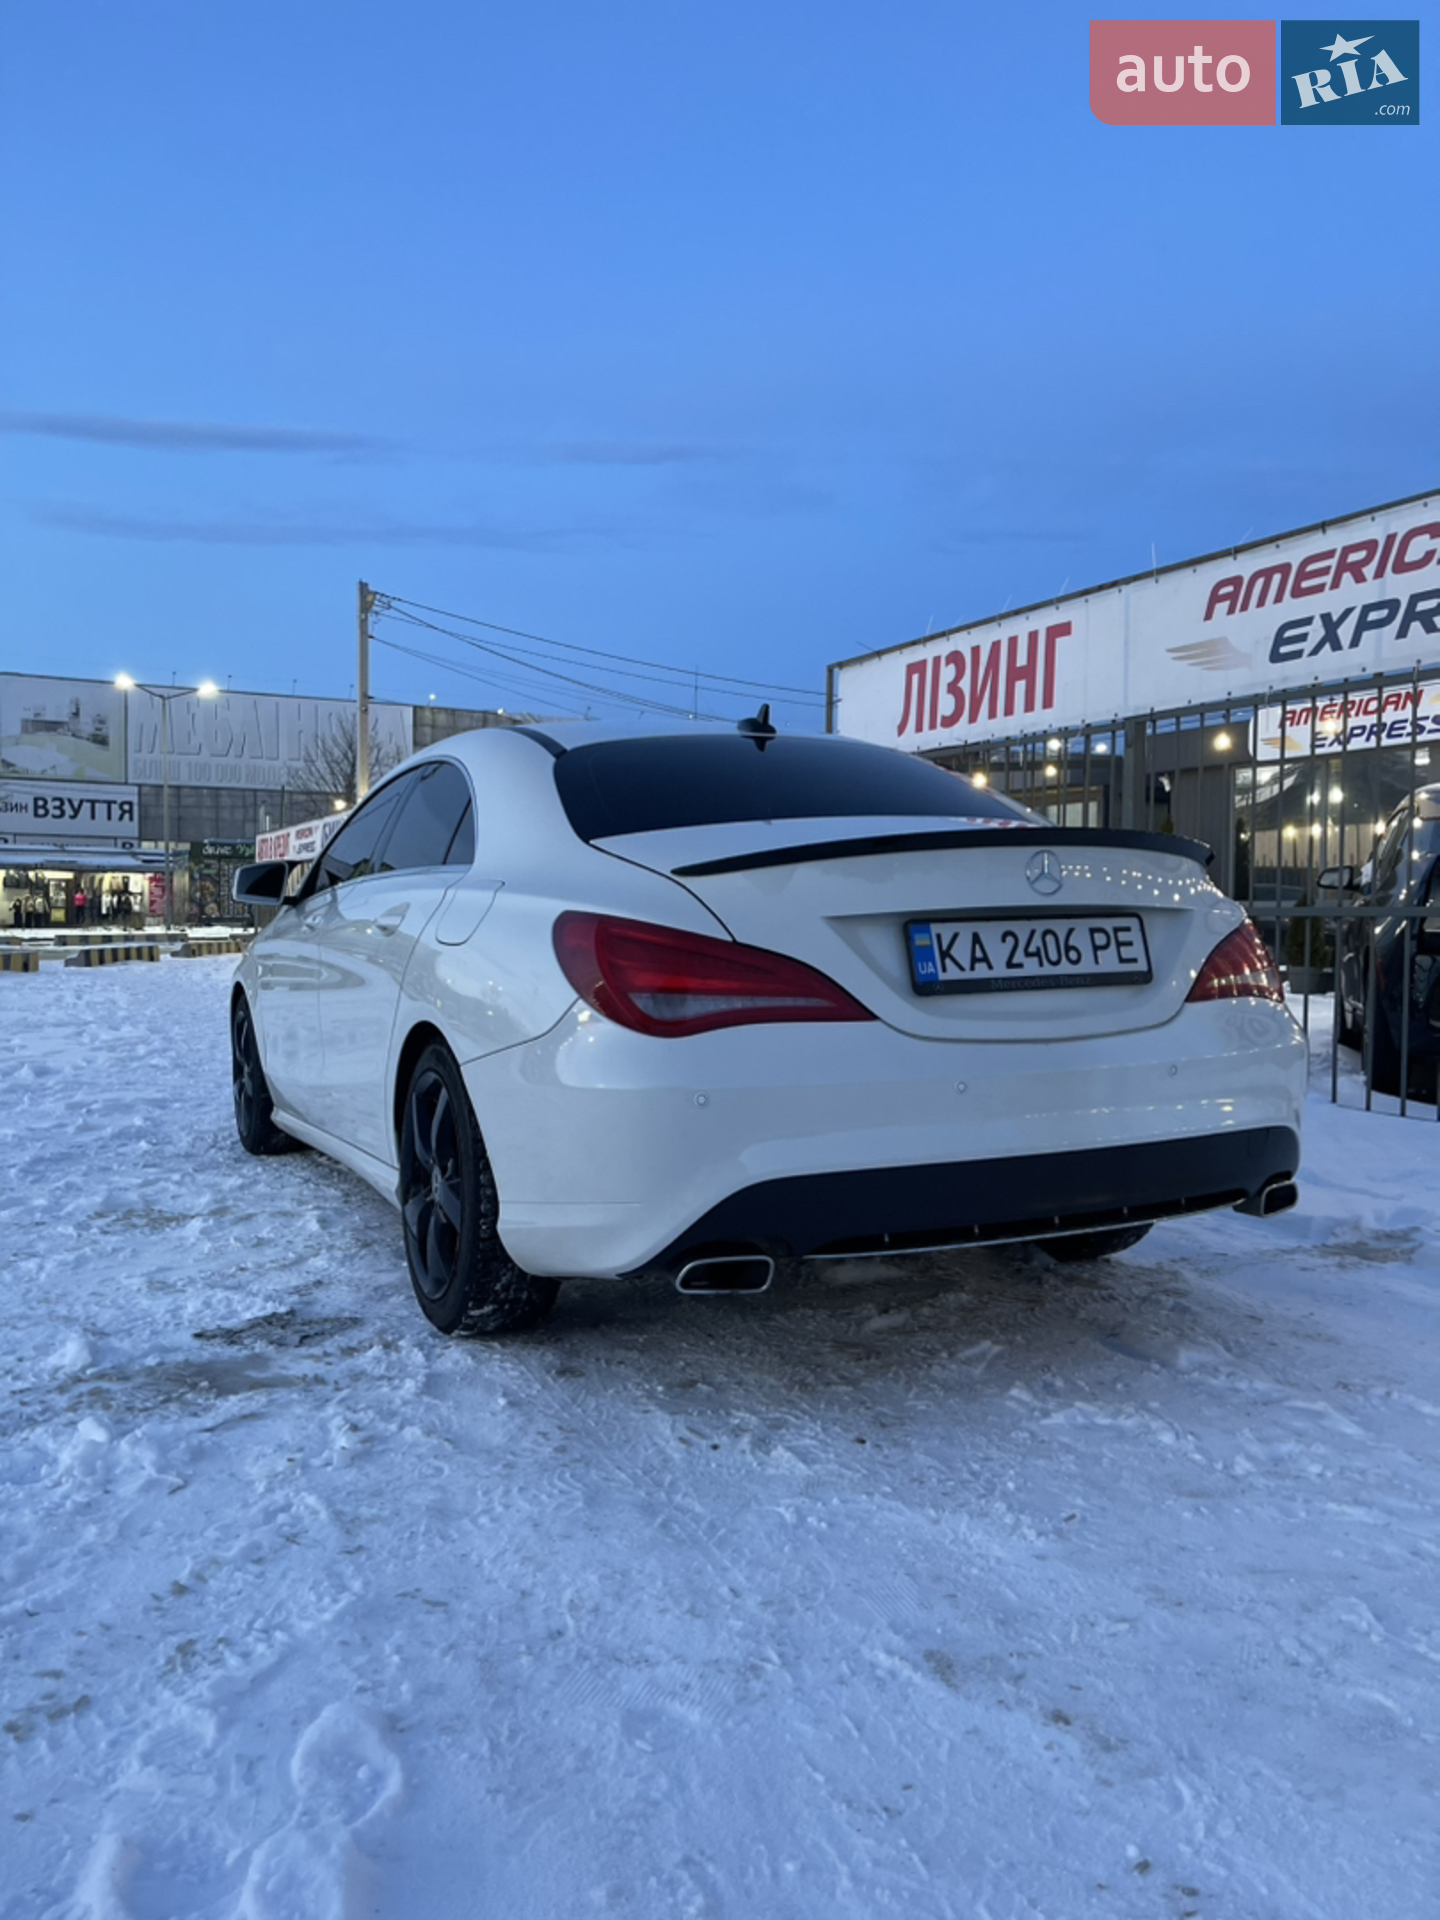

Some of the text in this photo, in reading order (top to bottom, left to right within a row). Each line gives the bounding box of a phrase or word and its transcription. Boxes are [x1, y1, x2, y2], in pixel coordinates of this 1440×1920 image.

[1203, 521, 1440, 623] AMERIC
[896, 620, 1073, 738] ЛІЗИНГ
[1277, 689, 1425, 729] AMERICAN
[185, 761, 212, 782] 100
[214, 763, 242, 784] 000
[33, 797, 134, 822] ВЗУТТЯ
[918, 926, 1138, 975] UA KA 2406 PE
